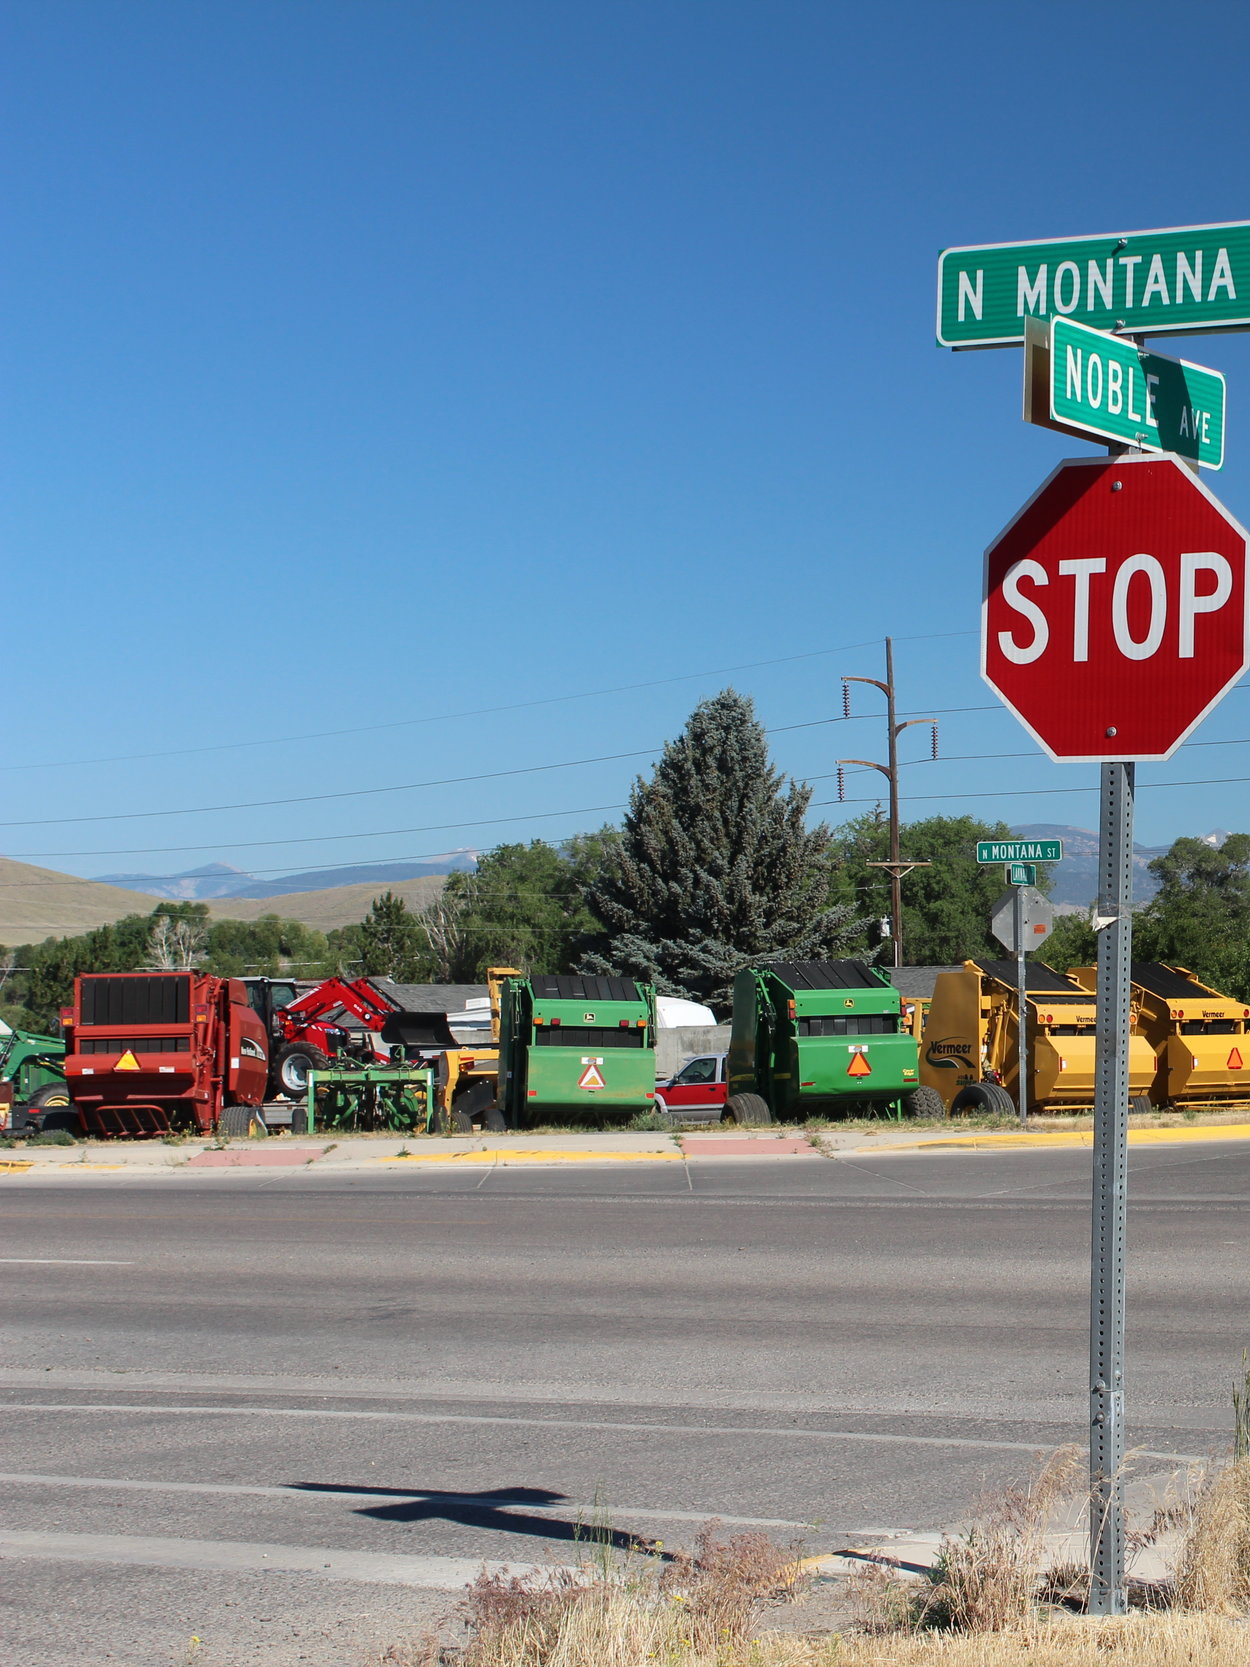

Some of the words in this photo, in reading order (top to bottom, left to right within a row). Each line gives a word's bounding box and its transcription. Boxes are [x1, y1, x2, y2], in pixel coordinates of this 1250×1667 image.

[957, 269, 983, 322] N
[1016, 247, 1237, 317] MONTANA
[1065, 345, 1159, 427] NOBLE
[1179, 405, 1211, 445] AVE
[997, 551, 1233, 665] STOP
[982, 849, 988, 860] N
[991, 844, 1043, 860] MONTANA
[1047, 847, 1056, 858] ST
[1076, 1015, 1097, 1023] Vermee
[1202, 1010, 1225, 1018] Vermeer
[931, 1041, 972, 1054] Vermeer
